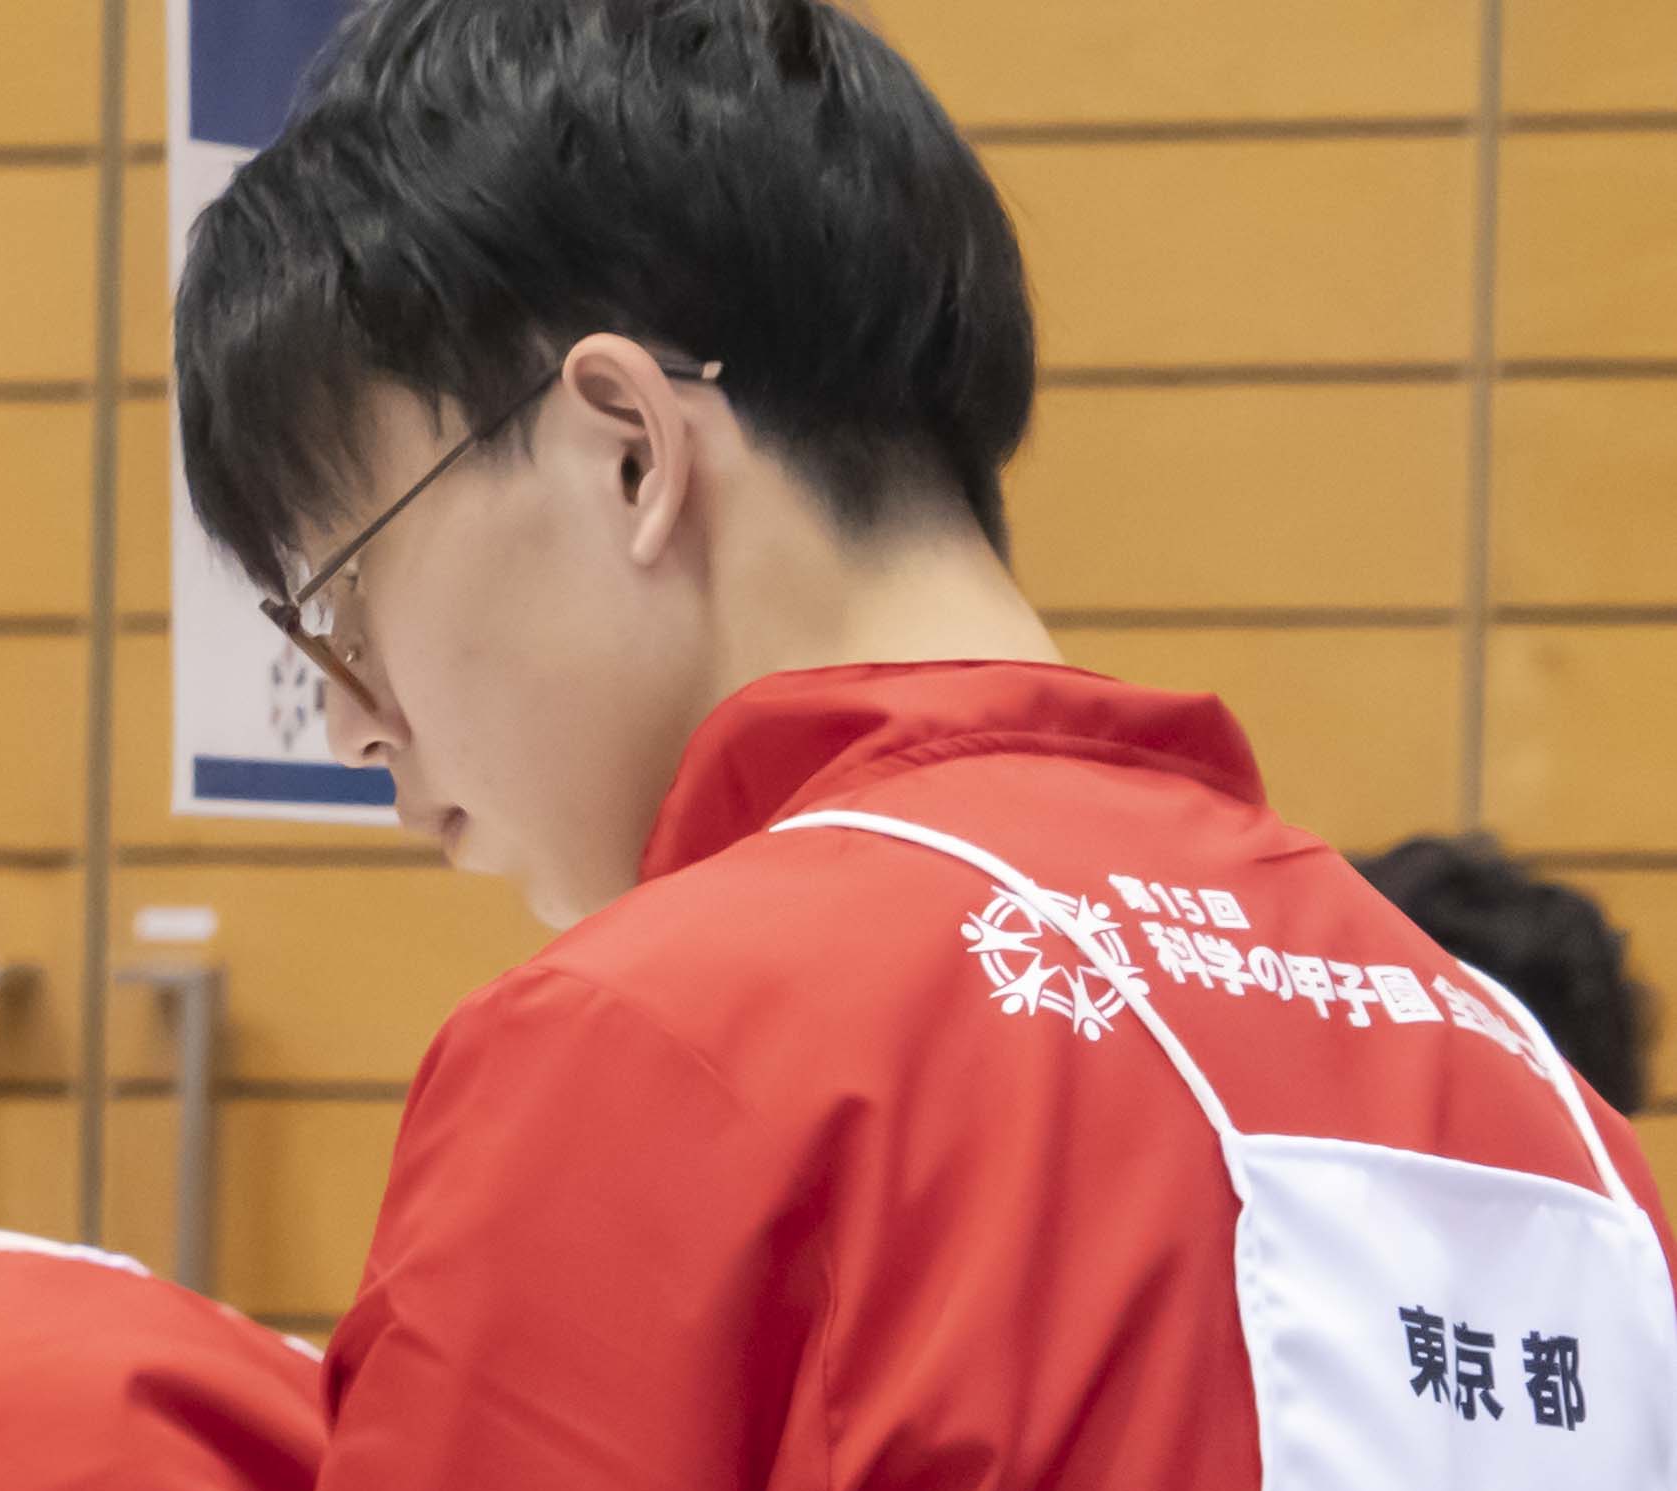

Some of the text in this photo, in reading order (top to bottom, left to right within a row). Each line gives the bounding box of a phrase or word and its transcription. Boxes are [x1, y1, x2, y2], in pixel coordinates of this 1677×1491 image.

[1108, 873, 1251, 930] 第15回
[1140, 921, 1445, 1029] 科学の甲子園
